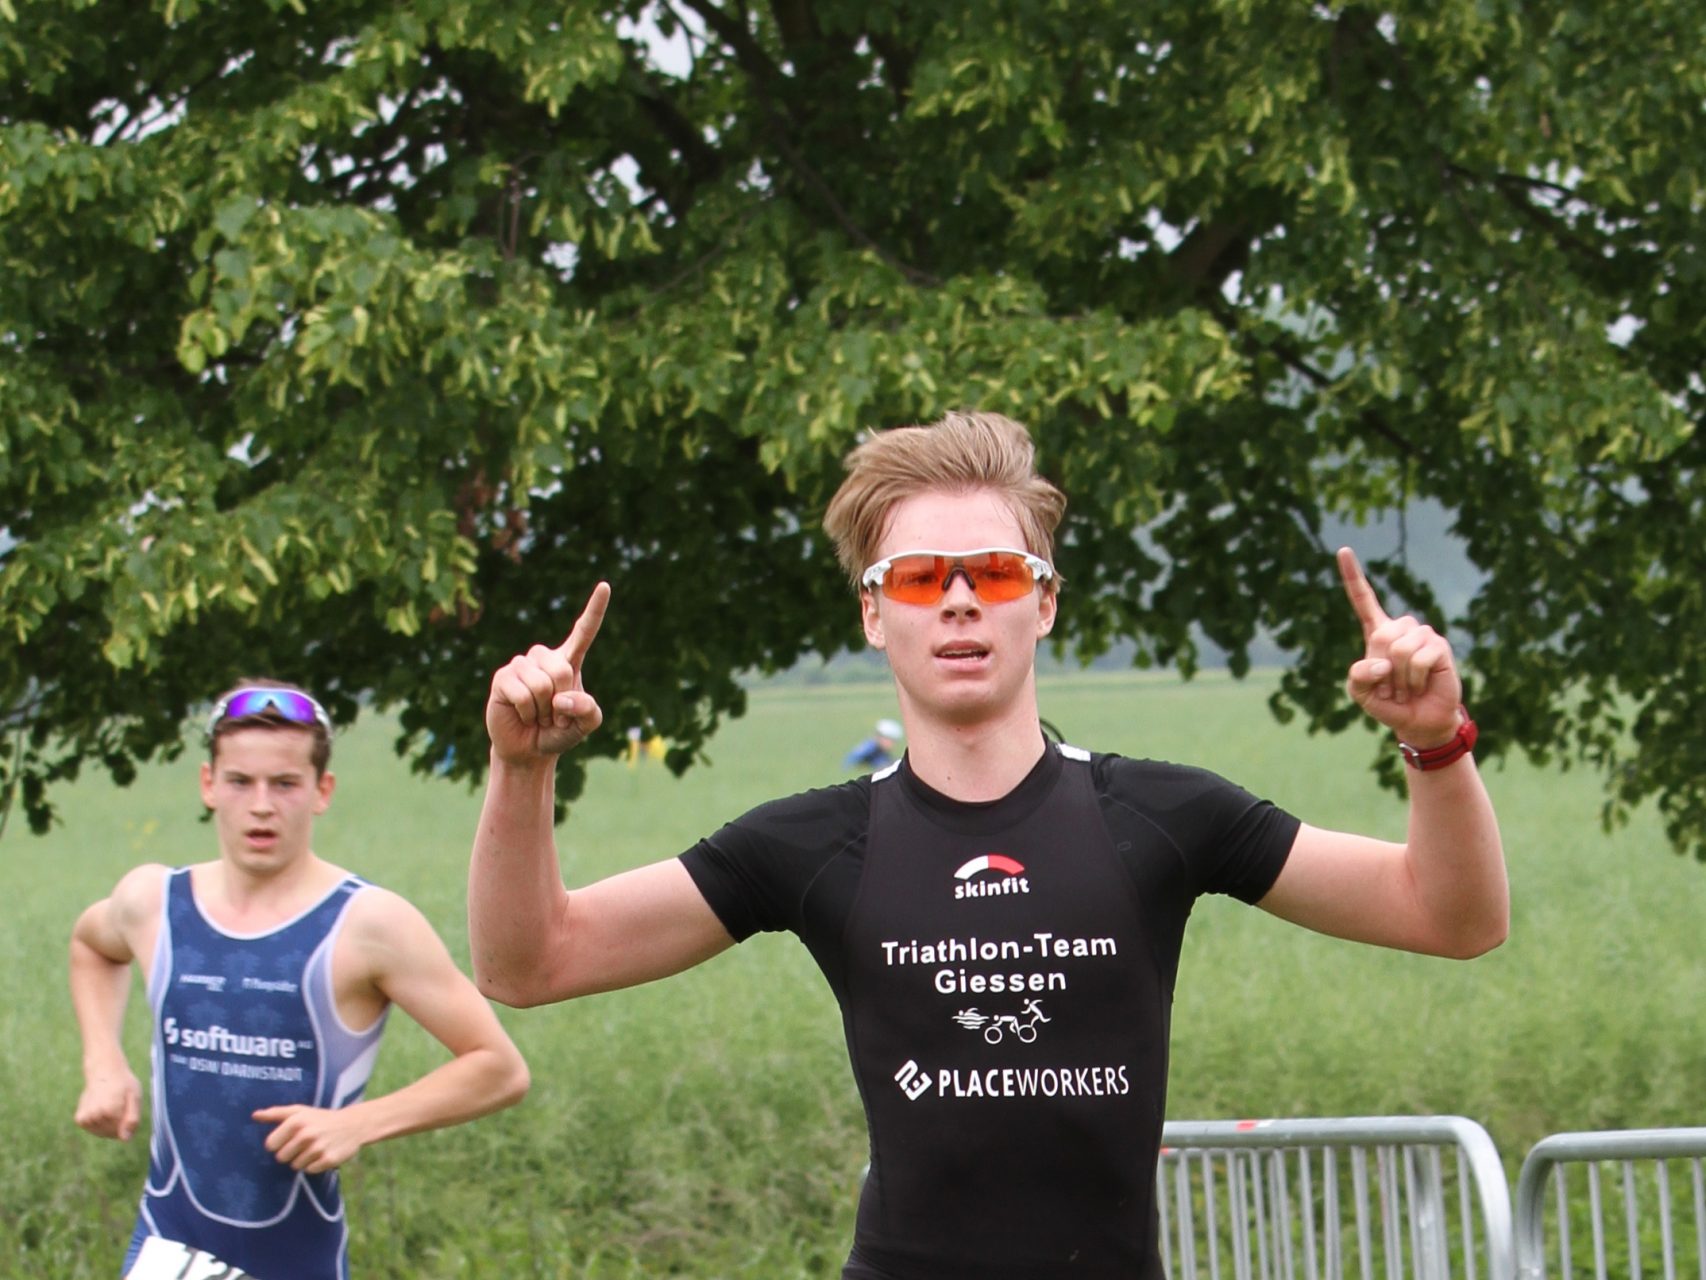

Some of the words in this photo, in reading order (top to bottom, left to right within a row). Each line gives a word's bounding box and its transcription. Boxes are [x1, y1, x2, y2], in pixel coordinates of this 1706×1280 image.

[954, 876, 1030, 899] skinfit
[881, 933, 1117, 966] Triathlon-Team
[934, 968, 1067, 994] Giessen
[181, 1025, 297, 1058] software
[938, 1065, 1130, 1097] PLACEWORKERS
